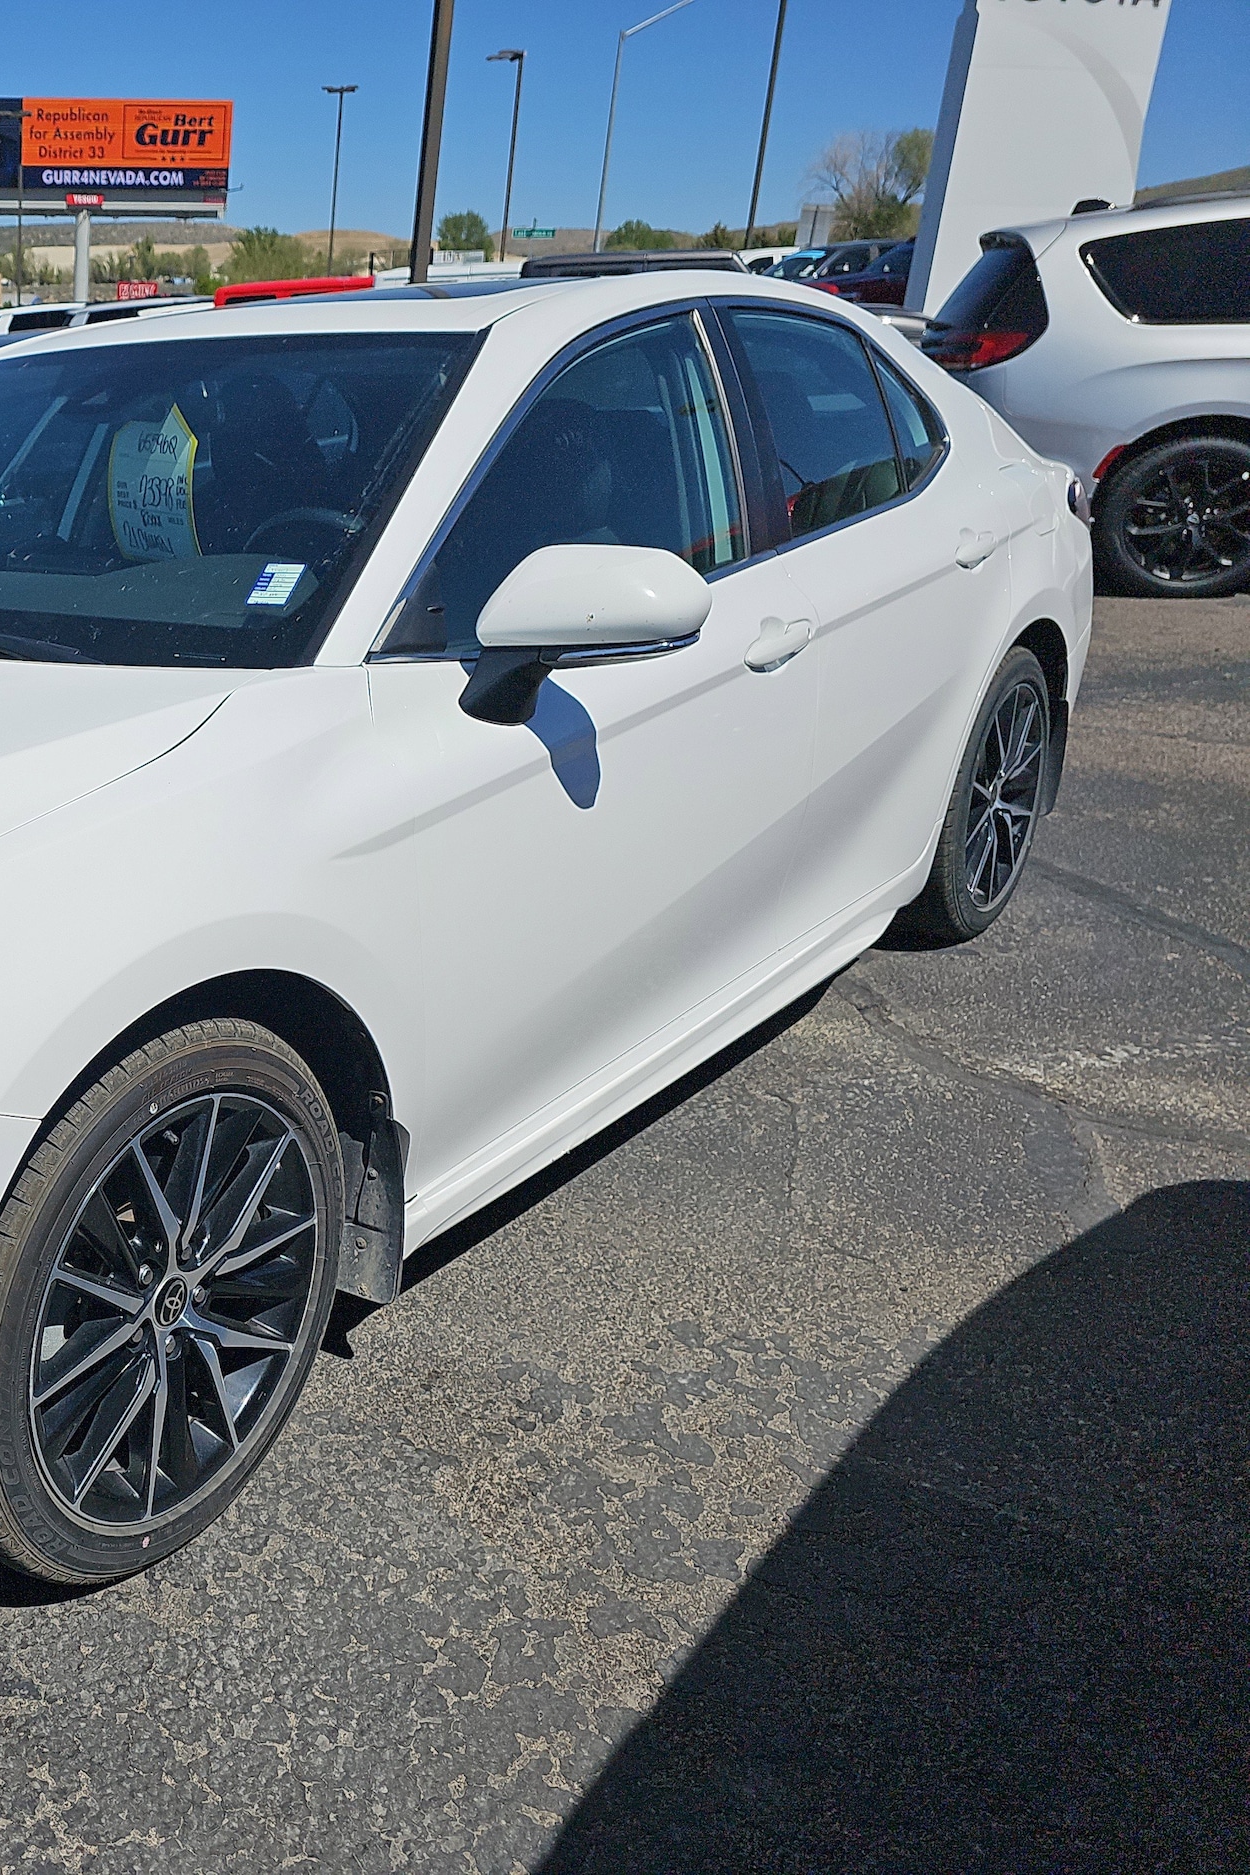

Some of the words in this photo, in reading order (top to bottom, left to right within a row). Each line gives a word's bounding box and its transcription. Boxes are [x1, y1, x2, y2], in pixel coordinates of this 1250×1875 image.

[36, 106, 109, 125] Republican
[174, 113, 214, 126] Bert
[29, 125, 48, 140] for
[53, 126, 115, 145] Assembly
[135, 122, 214, 146] Gurr
[38, 144, 84, 159] District
[88, 145, 105, 159] 33
[41, 169, 185, 186] GURR4NEVADA.COM
[300, 1088, 335, 1153] ROAD
[11, 1494, 67, 1553] ROAD
